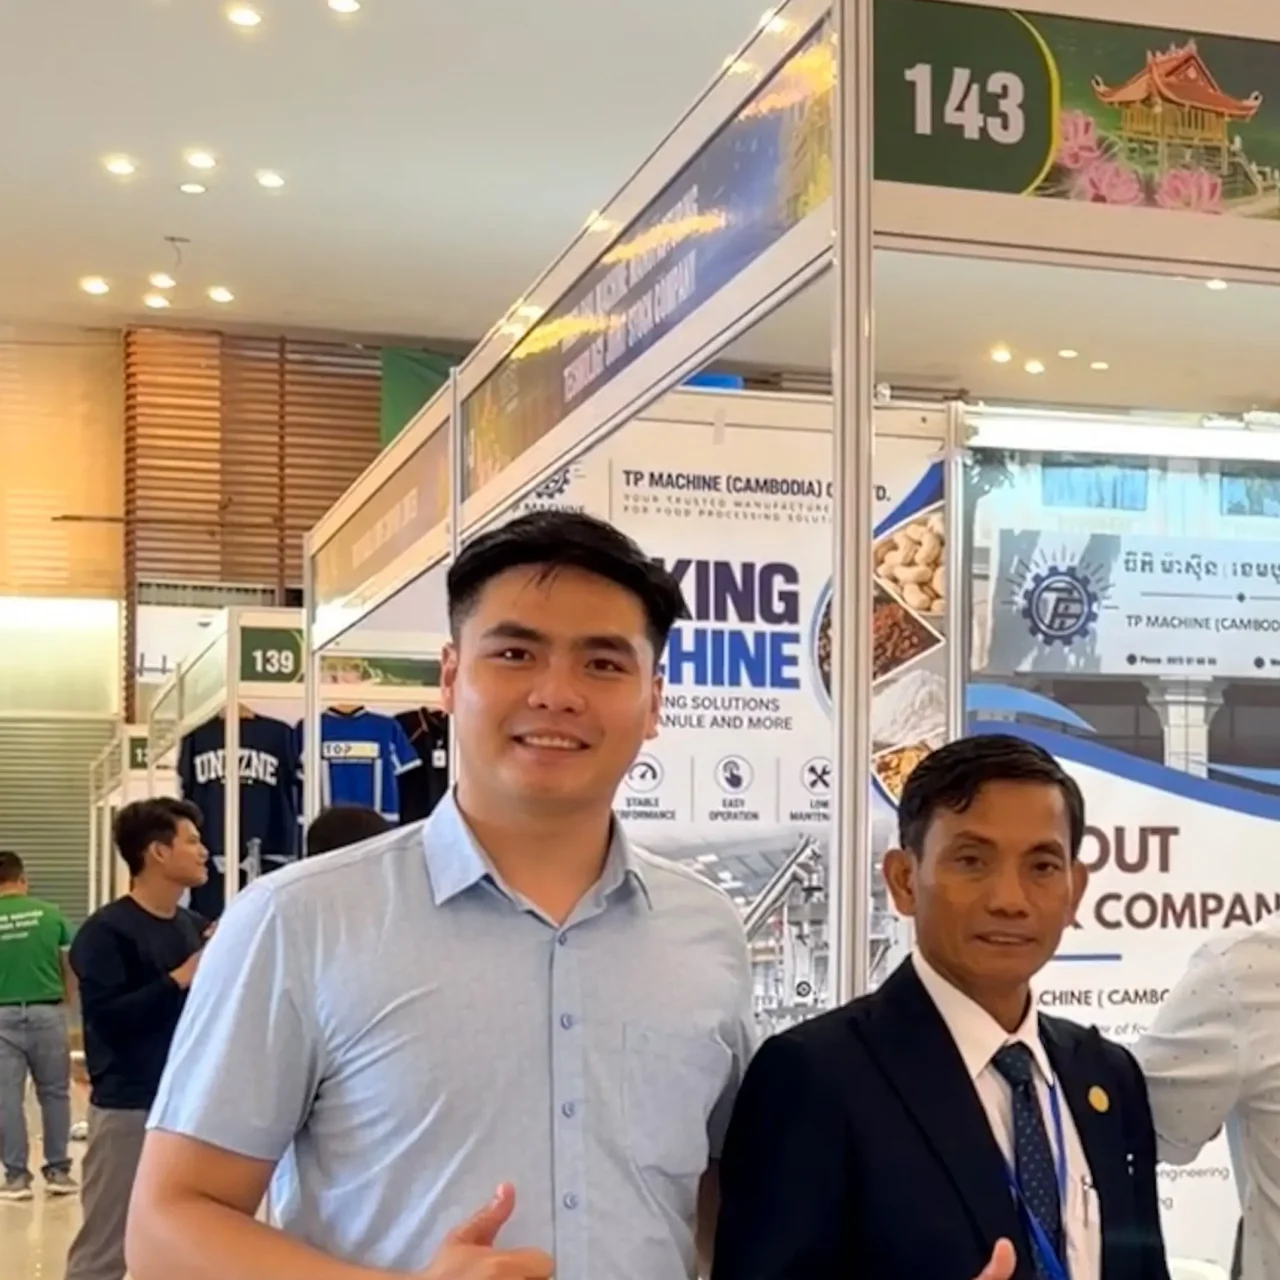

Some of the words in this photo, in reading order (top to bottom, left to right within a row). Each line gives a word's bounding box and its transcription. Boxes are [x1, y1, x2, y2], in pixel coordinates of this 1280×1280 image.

[903, 63, 1025, 145] 143
[622, 469, 645, 487] TP
[648, 471, 722, 492] MACHINE
[726, 474, 822, 499] (CAMBODIA)
[651, 557, 800, 625] KING
[1126, 614, 1143, 627] TP
[1145, 615, 1211, 631] MACHINE
[252, 649, 295, 674] 139
[660, 627, 800, 690] HINE
[691, 696, 781, 712] SOLUTIONS
[709, 715, 744, 730] AND
[749, 716, 793, 730] MORE
[721, 798, 745, 809] EASY
[708, 811, 759, 821] OPERATION
[1078, 825, 1180, 874] OUT
[1038, 989, 1093, 1007] CHINE
[1158, 1166, 1230, 1182] ngineering
